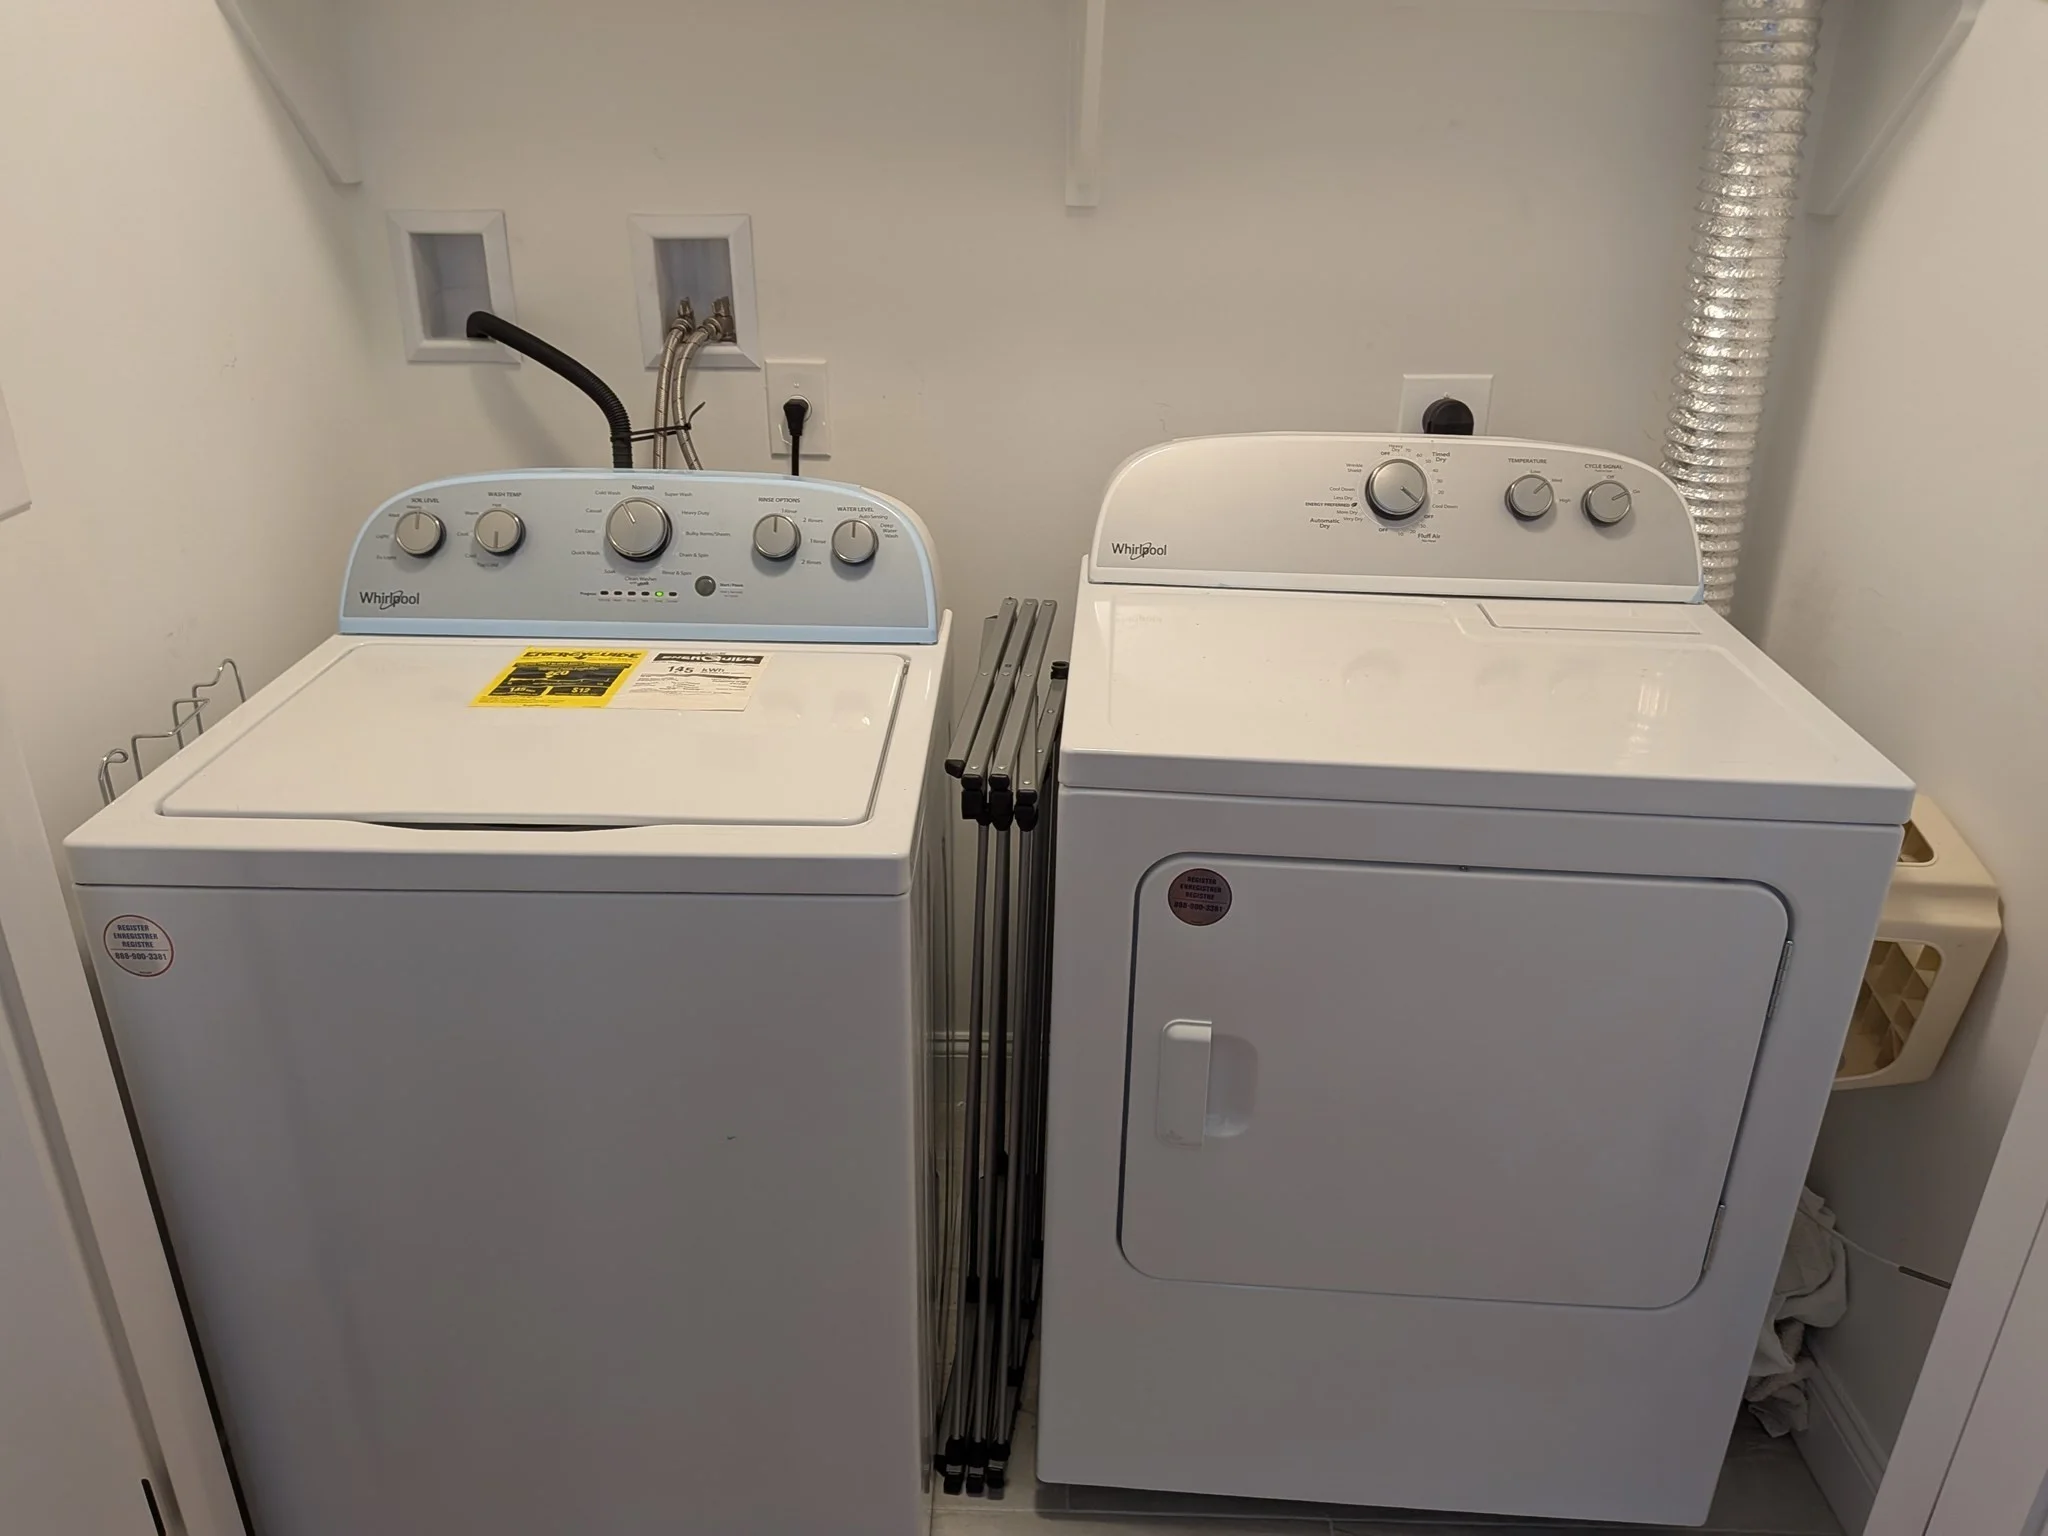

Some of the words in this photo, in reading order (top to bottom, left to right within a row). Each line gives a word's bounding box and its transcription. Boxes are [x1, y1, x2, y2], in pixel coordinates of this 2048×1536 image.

[1112, 542, 1166, 560] Whirlpool
[360, 590, 420, 610] Whirlpool
[1187, 876, 1216, 884] REGISTER
[1180, 884, 1222, 893] ENREGISTRER
